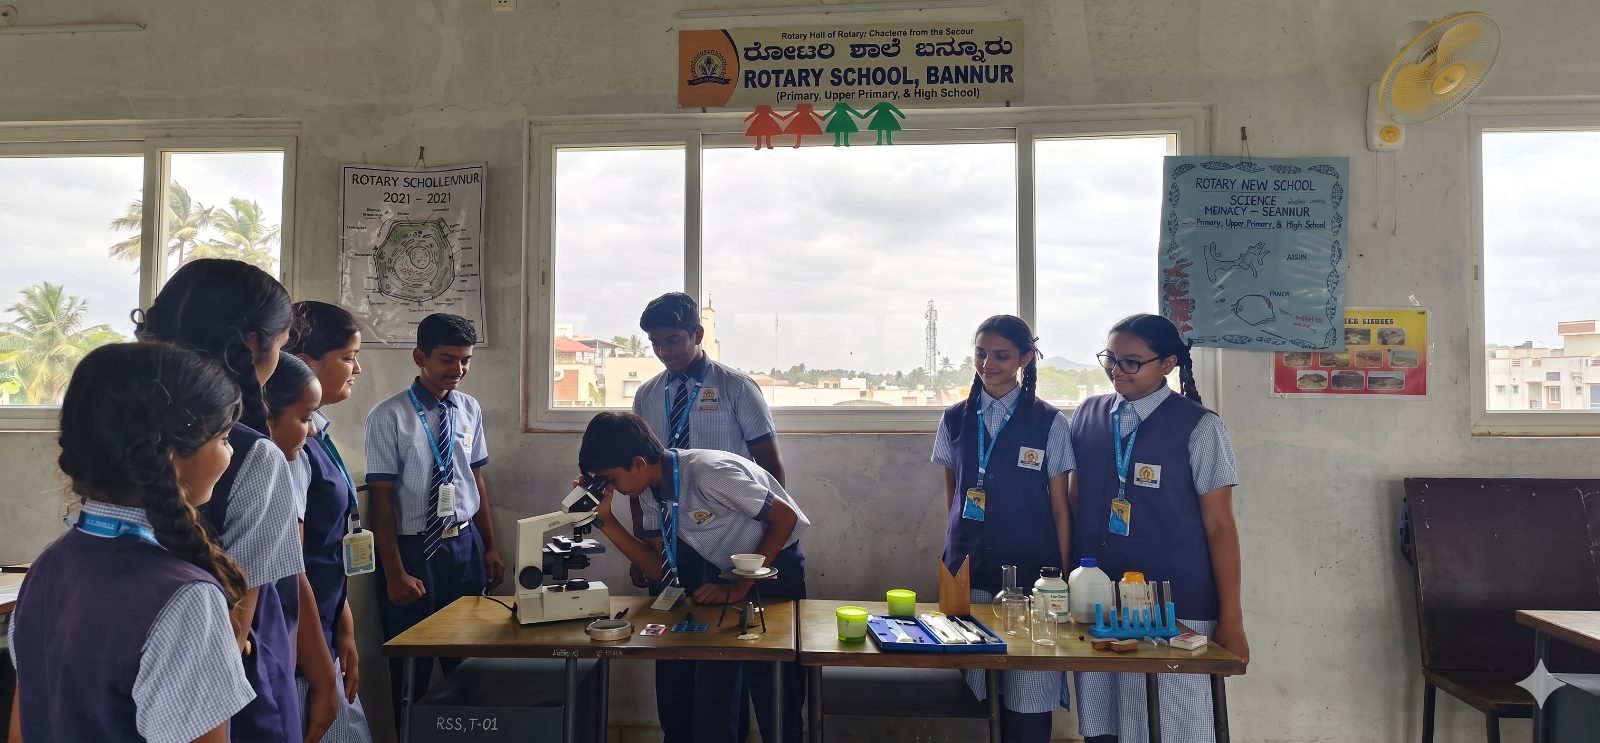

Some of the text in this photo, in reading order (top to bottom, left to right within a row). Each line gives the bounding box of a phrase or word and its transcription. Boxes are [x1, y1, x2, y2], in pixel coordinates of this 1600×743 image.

[781, 32, 808, 40] Rotary
[744, 42, 836, 60] ರೋಟರಿ
[850, 38, 901, 58] ಶಾಲೆ
[744, 64, 1014, 88] ROTARY SCHOOL, BANNUR
[776, 88, 980, 103] (Primary, Upper Primary, & High School)
[352, 174, 400, 187] ROTARY
[1196, 178, 1316, 191] ROTARY NEW SCHOOL
[383, 192, 410, 204] 2021
[427, 192, 451, 204] 2021
[1230, 195, 1278, 206] SCIENCE
[1204, 206, 1248, 216] MEINACY
[1262, 206, 1310, 217] SEANNUR
[1226, 219, 1244, 230] Upper
[1276, 220, 1282, 228] &
[1286, 221, 1302, 231] High
[1305, 220, 1326, 228] School
